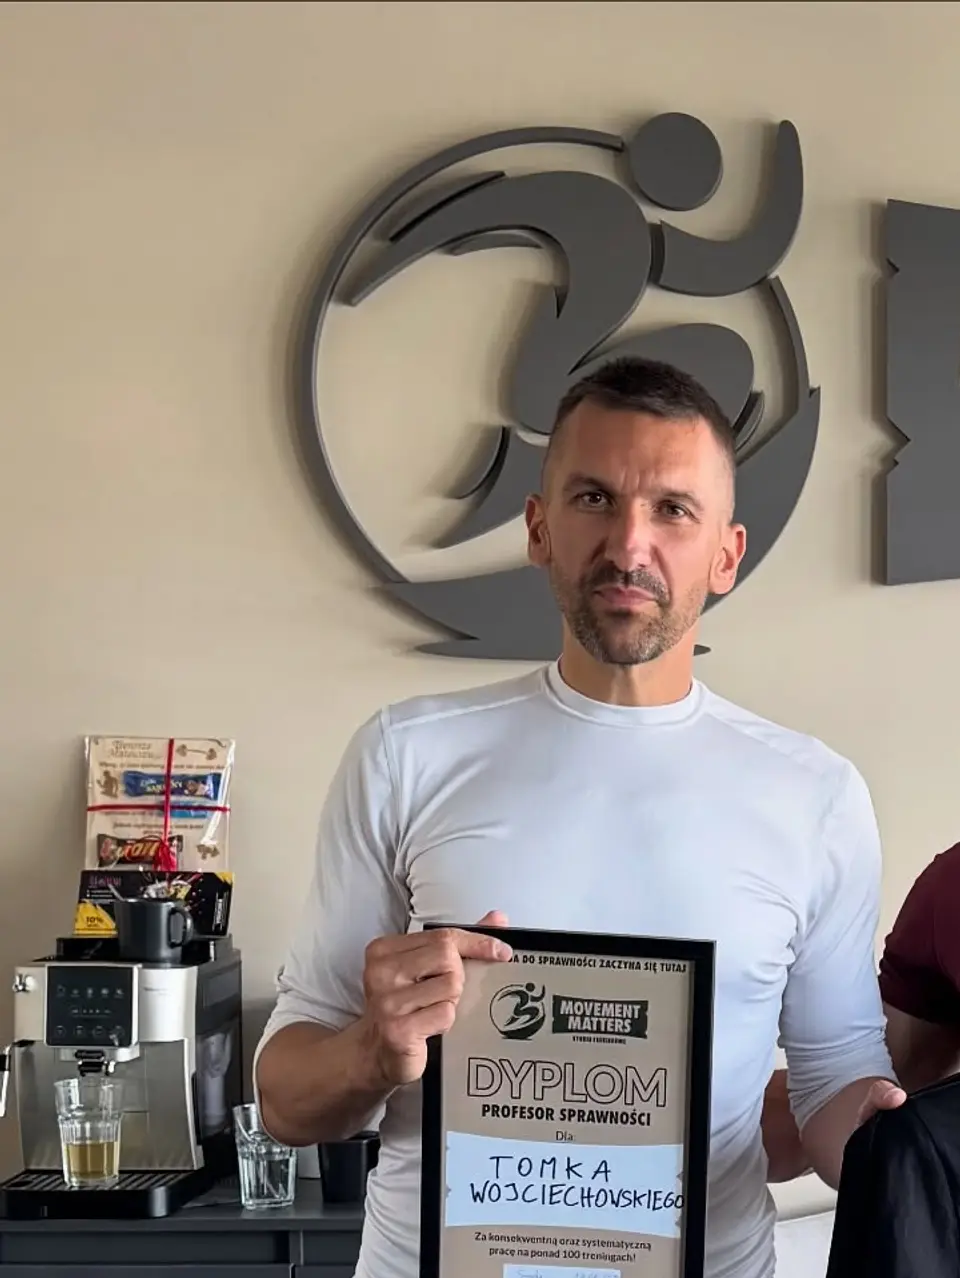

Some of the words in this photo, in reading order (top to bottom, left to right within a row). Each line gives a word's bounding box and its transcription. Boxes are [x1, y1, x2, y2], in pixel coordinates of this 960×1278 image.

[522, 954, 535, 964] DO
[538, 955, 597, 968] SPRAWNOŚCI
[599, 959, 642, 970] ZACZYNA
[643, 961, 658, 974] SIĘ
[659, 962, 687, 973] TUTAJ
[560, 1001, 641, 1019] MOVEMENT
[567, 1017, 632, 1034] MATTERS
[467, 1057, 667, 1107] DYPLOM
[481, 1104, 554, 1121] PROFESOR
[560, 1109, 651, 1126] SPRAWNOŚCI
[489, 1156, 612, 1182] TOMKA
[475, 1232, 487, 1241] Za
[530, 1248, 560, 1258] ponad
[563, 1250, 580, 1259] 100
